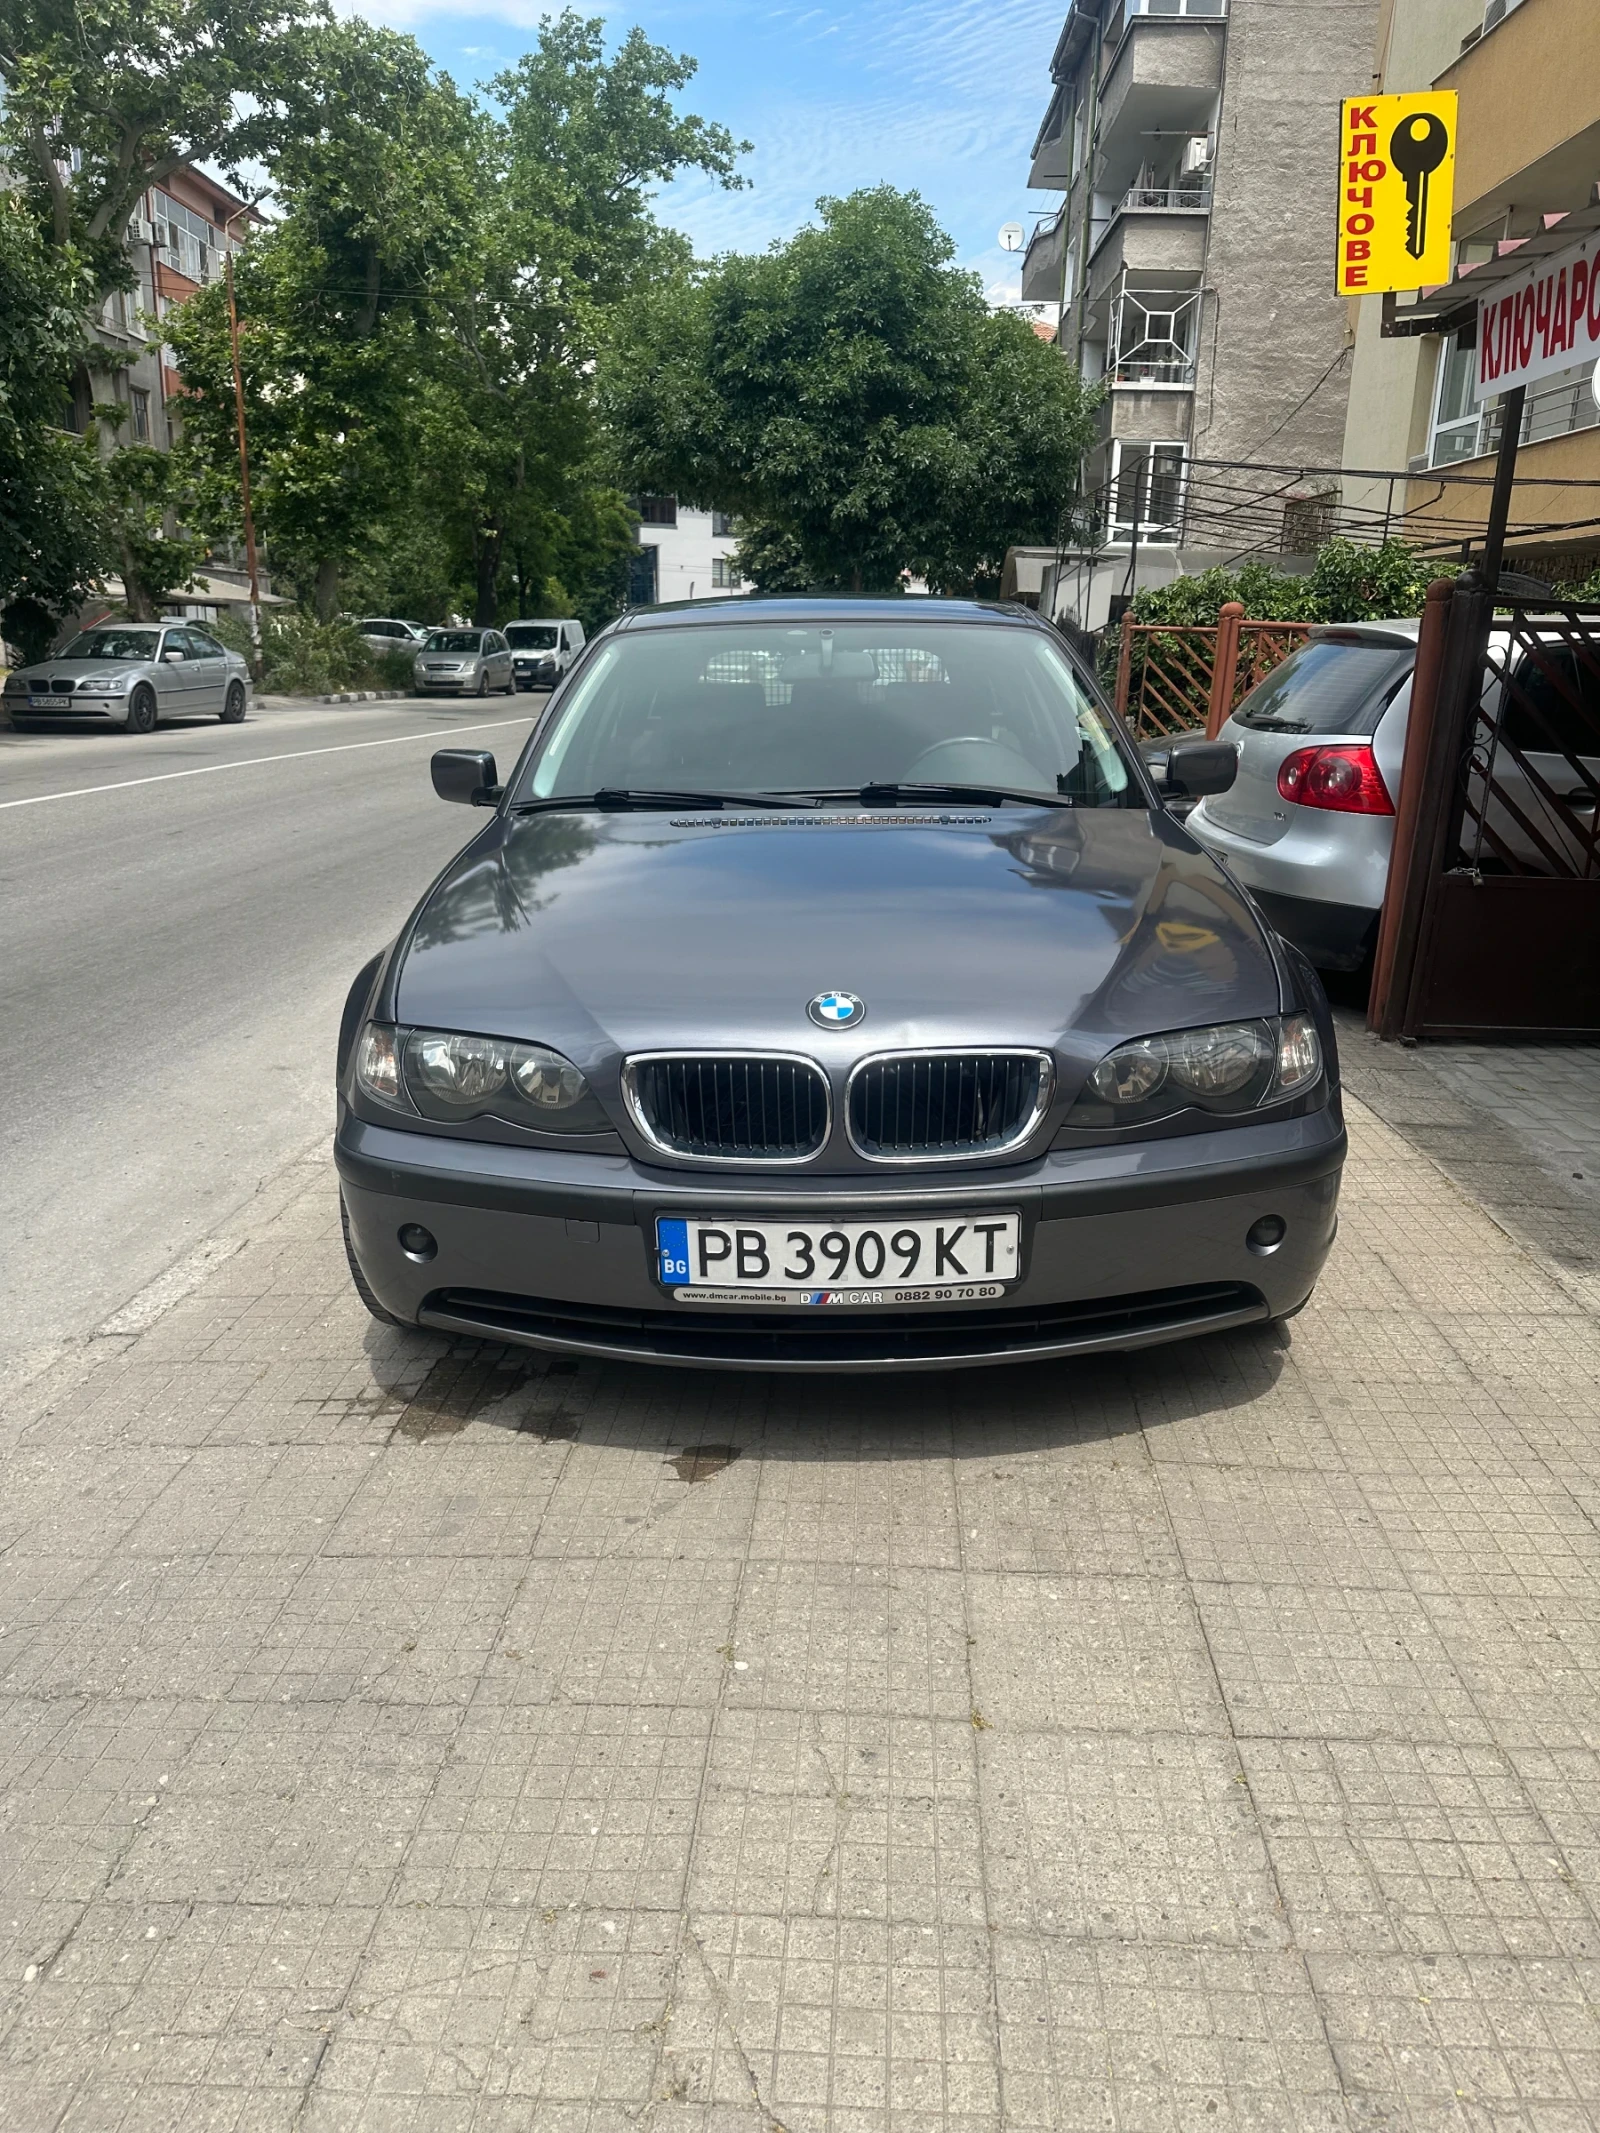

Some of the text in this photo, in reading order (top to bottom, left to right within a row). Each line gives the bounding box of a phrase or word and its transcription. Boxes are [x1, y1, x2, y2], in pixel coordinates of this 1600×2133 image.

[1345, 105, 1387, 287] КЛЮЧОВЕ
[664, 1258, 687, 1275] BG
[697, 1222, 1007, 1281] PB 3909 KT
[682, 1291, 787, 1303] www.dmcar.mobile.bg
[849, 1291, 884, 1304] CAR
[894, 1291, 931, 1301] 0882
[934, 1289, 953, 1300] 90
[957, 1288, 975, 1299] 70
[978, 1286, 997, 1297] 80
